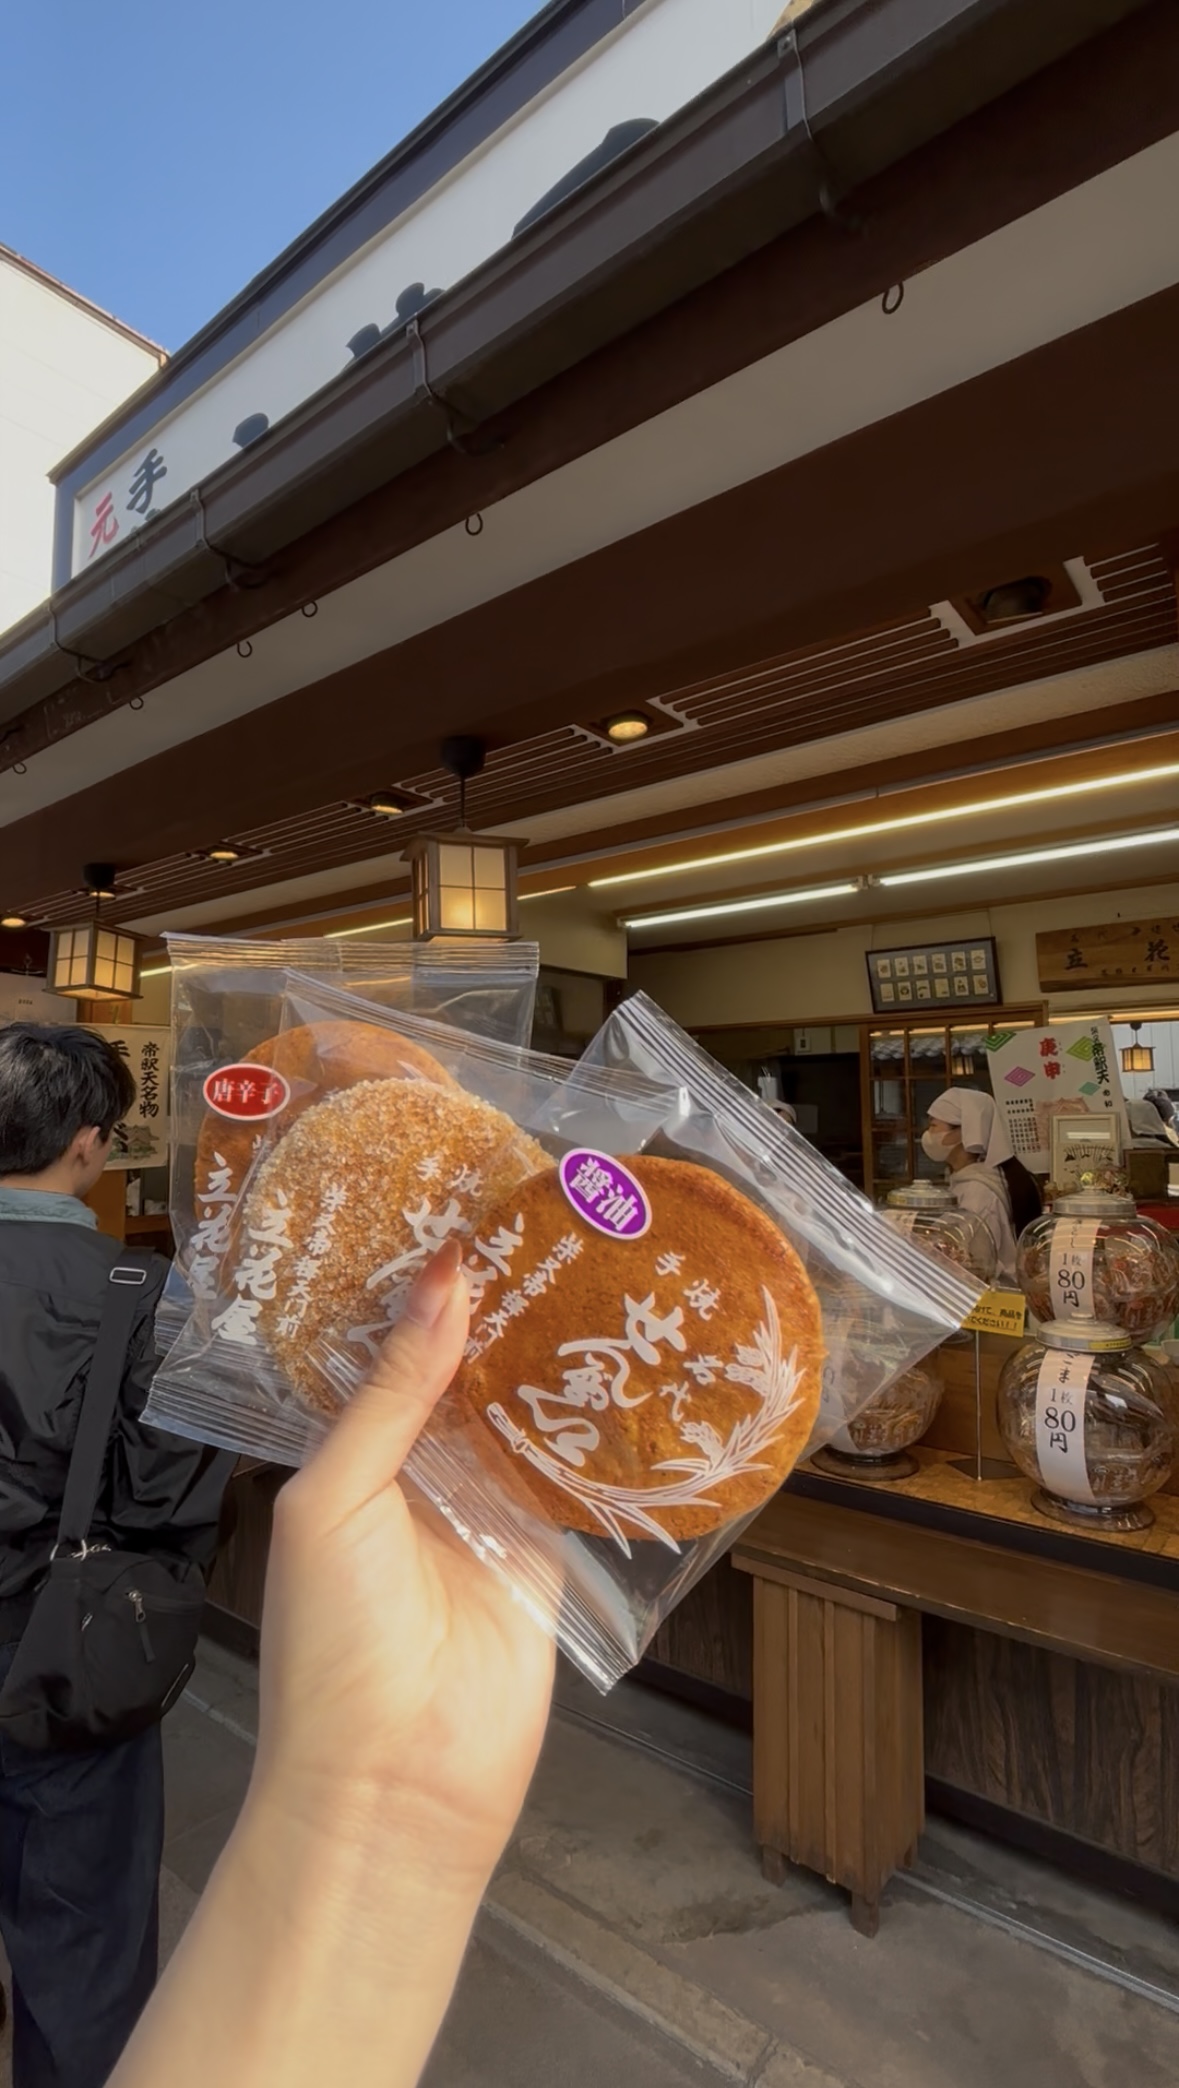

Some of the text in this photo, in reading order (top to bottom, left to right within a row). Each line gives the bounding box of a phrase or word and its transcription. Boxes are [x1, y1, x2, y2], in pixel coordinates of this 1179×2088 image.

[1039, 1037, 1062, 1080] 庚申
[139, 1041, 160, 1118] 帝釈天名物
[212, 1079, 280, 1105] 唐辛子
[211, 1188, 294, 1345] 立花屋
[1057, 1269, 1085, 1290] 80
[1044, 1407, 1076, 1432] 80
